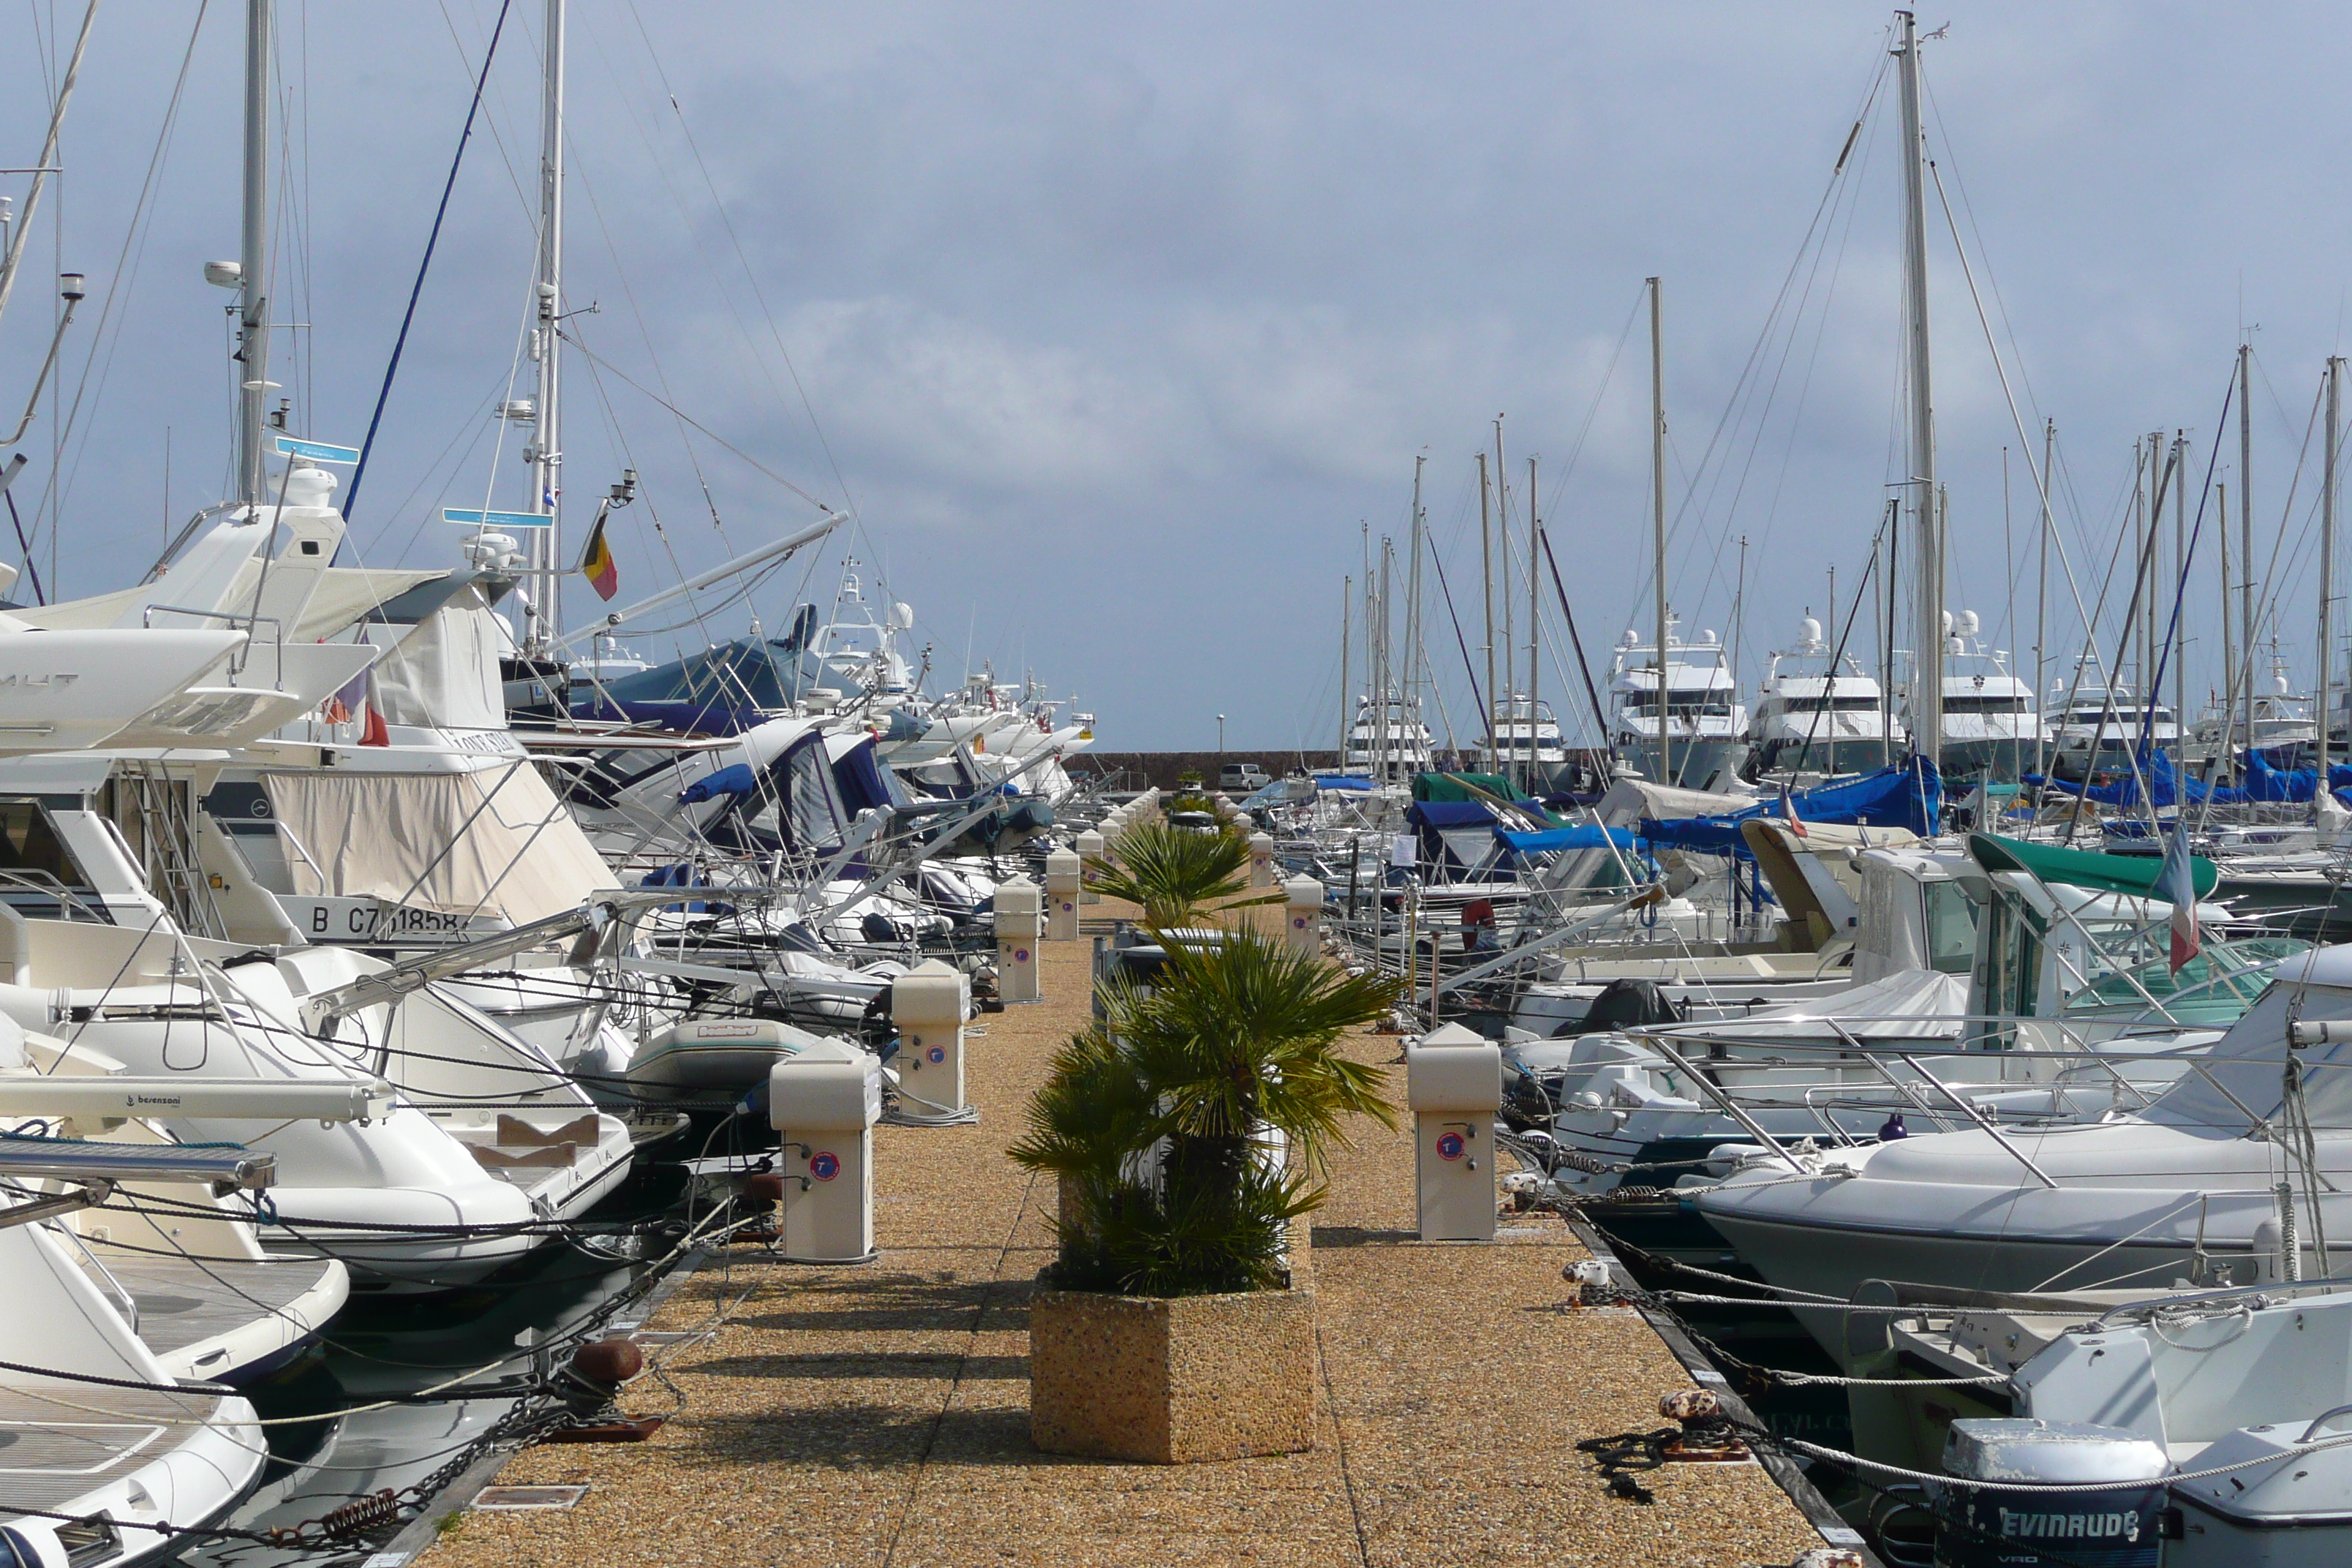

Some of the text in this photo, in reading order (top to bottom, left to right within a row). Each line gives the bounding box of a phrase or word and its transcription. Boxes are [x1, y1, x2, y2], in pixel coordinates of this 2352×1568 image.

[312, 906, 328, 932] B
[137, 1094, 181, 1104] besenzoni
[2001, 1512, 2138, 1538] EVINRUDE
[1998, 1555, 2038, 1564] VRO
